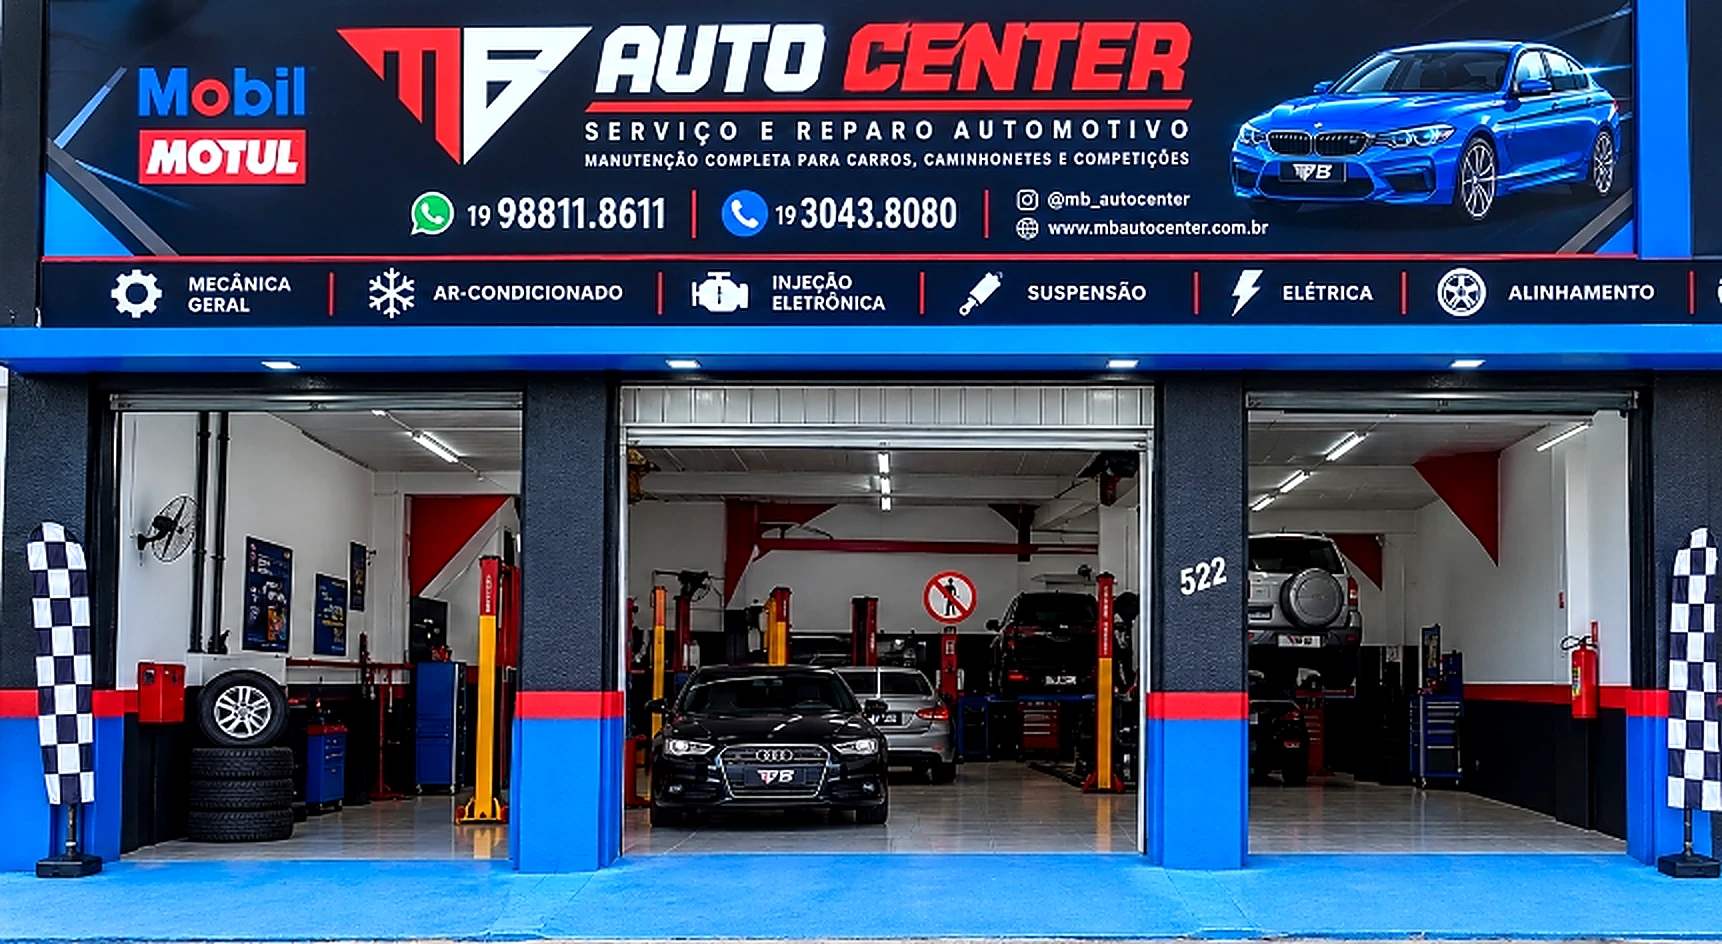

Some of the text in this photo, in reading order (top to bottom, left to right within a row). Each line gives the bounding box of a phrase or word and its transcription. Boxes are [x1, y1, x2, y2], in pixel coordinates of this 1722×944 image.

[595, 21, 1192, 93] AUTO CENTER
[138, 66, 305, 117] Mobil
[585, 119, 1189, 147] SERVIÇO E REPARO AUTOMOTIVO
[146, 139, 299, 175] MOTUL
[585, 149, 1189, 171] MANUTENÇÃO COMPLETA PARA CARROS, CAMINHONETES E COMPETIÇÕES
[1048, 191, 1191, 210] @mb_autocenter
[468, 198, 666, 230] 19 98811.8611
[775, 197, 957, 230] 19 3043.8080
[1048, 219, 1269, 236] www.mbautocenter.com.br
[188, 272, 292, 293] MECÂNICA
[433, 284, 623, 302] AR-CONDICIONADO
[772, 272, 853, 293] INJEÇÃO
[1027, 281, 1147, 302] SUSPENSÃO
[1283, 281, 1374, 302] ELÉTRICA
[1508, 284, 1655, 302] ALINHAMENTO
[188, 297, 250, 314] GERAL
[772, 293, 886, 311] ELETRÔNICA
[1180, 556, 1227, 596] 522
